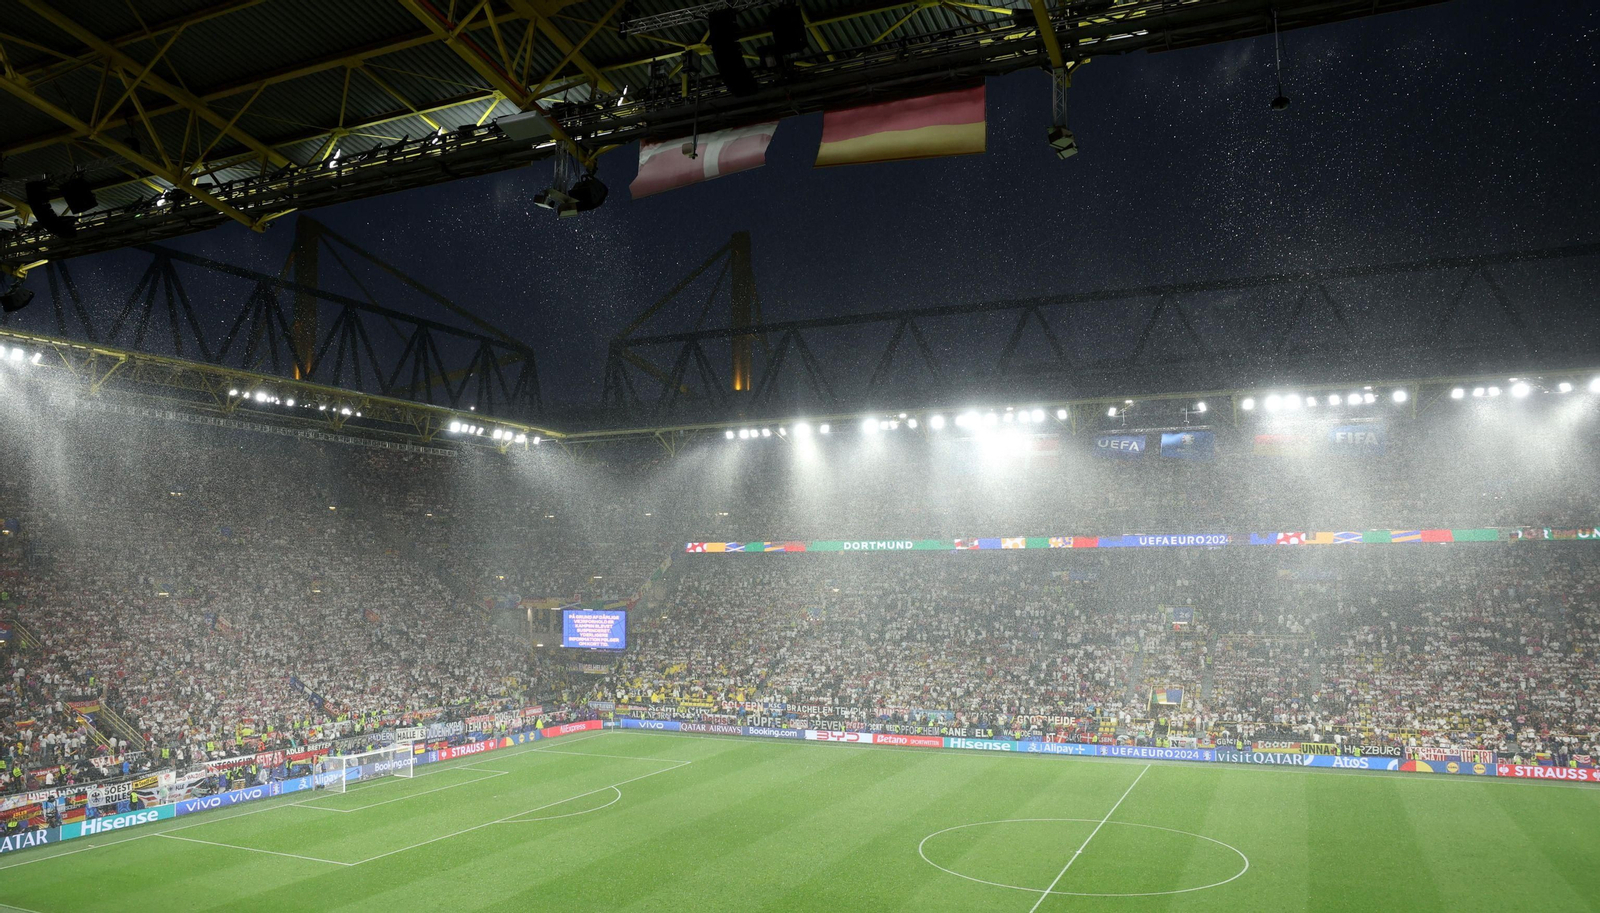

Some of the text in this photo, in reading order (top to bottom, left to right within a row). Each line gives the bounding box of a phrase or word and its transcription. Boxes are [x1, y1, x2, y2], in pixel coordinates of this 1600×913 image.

[1336, 432, 1378, 444] FIFA
[1098, 439, 1139, 452] UEFA
[843, 541, 913, 550] DORTMUND
[786, 704, 833, 714] BRACHELEN
[639, 721, 664, 729] vivo
[681, 723, 741, 734] QATAR AIRWAYS
[901, 725, 939, 736] PFORHEIM
[397, 731, 416, 742] HALLE
[749, 726, 797, 738] Booking.com
[816, 731, 860, 742] BYD
[877, 735, 907, 744] Betano
[950, 738, 1011, 751] Hisense
[286, 747, 305, 756] ADLER
[451, 742, 485, 757] STRAUSS
[1111, 747, 1199, 759] UEFAEURO2024
[1301, 743, 1330, 755] UNNA
[1514, 766, 1588, 780] STRAUSS
[104, 783, 131, 796] SOEST
[186, 789, 262, 812] vivo vivo
[81, 810, 158, 836] Hisense
